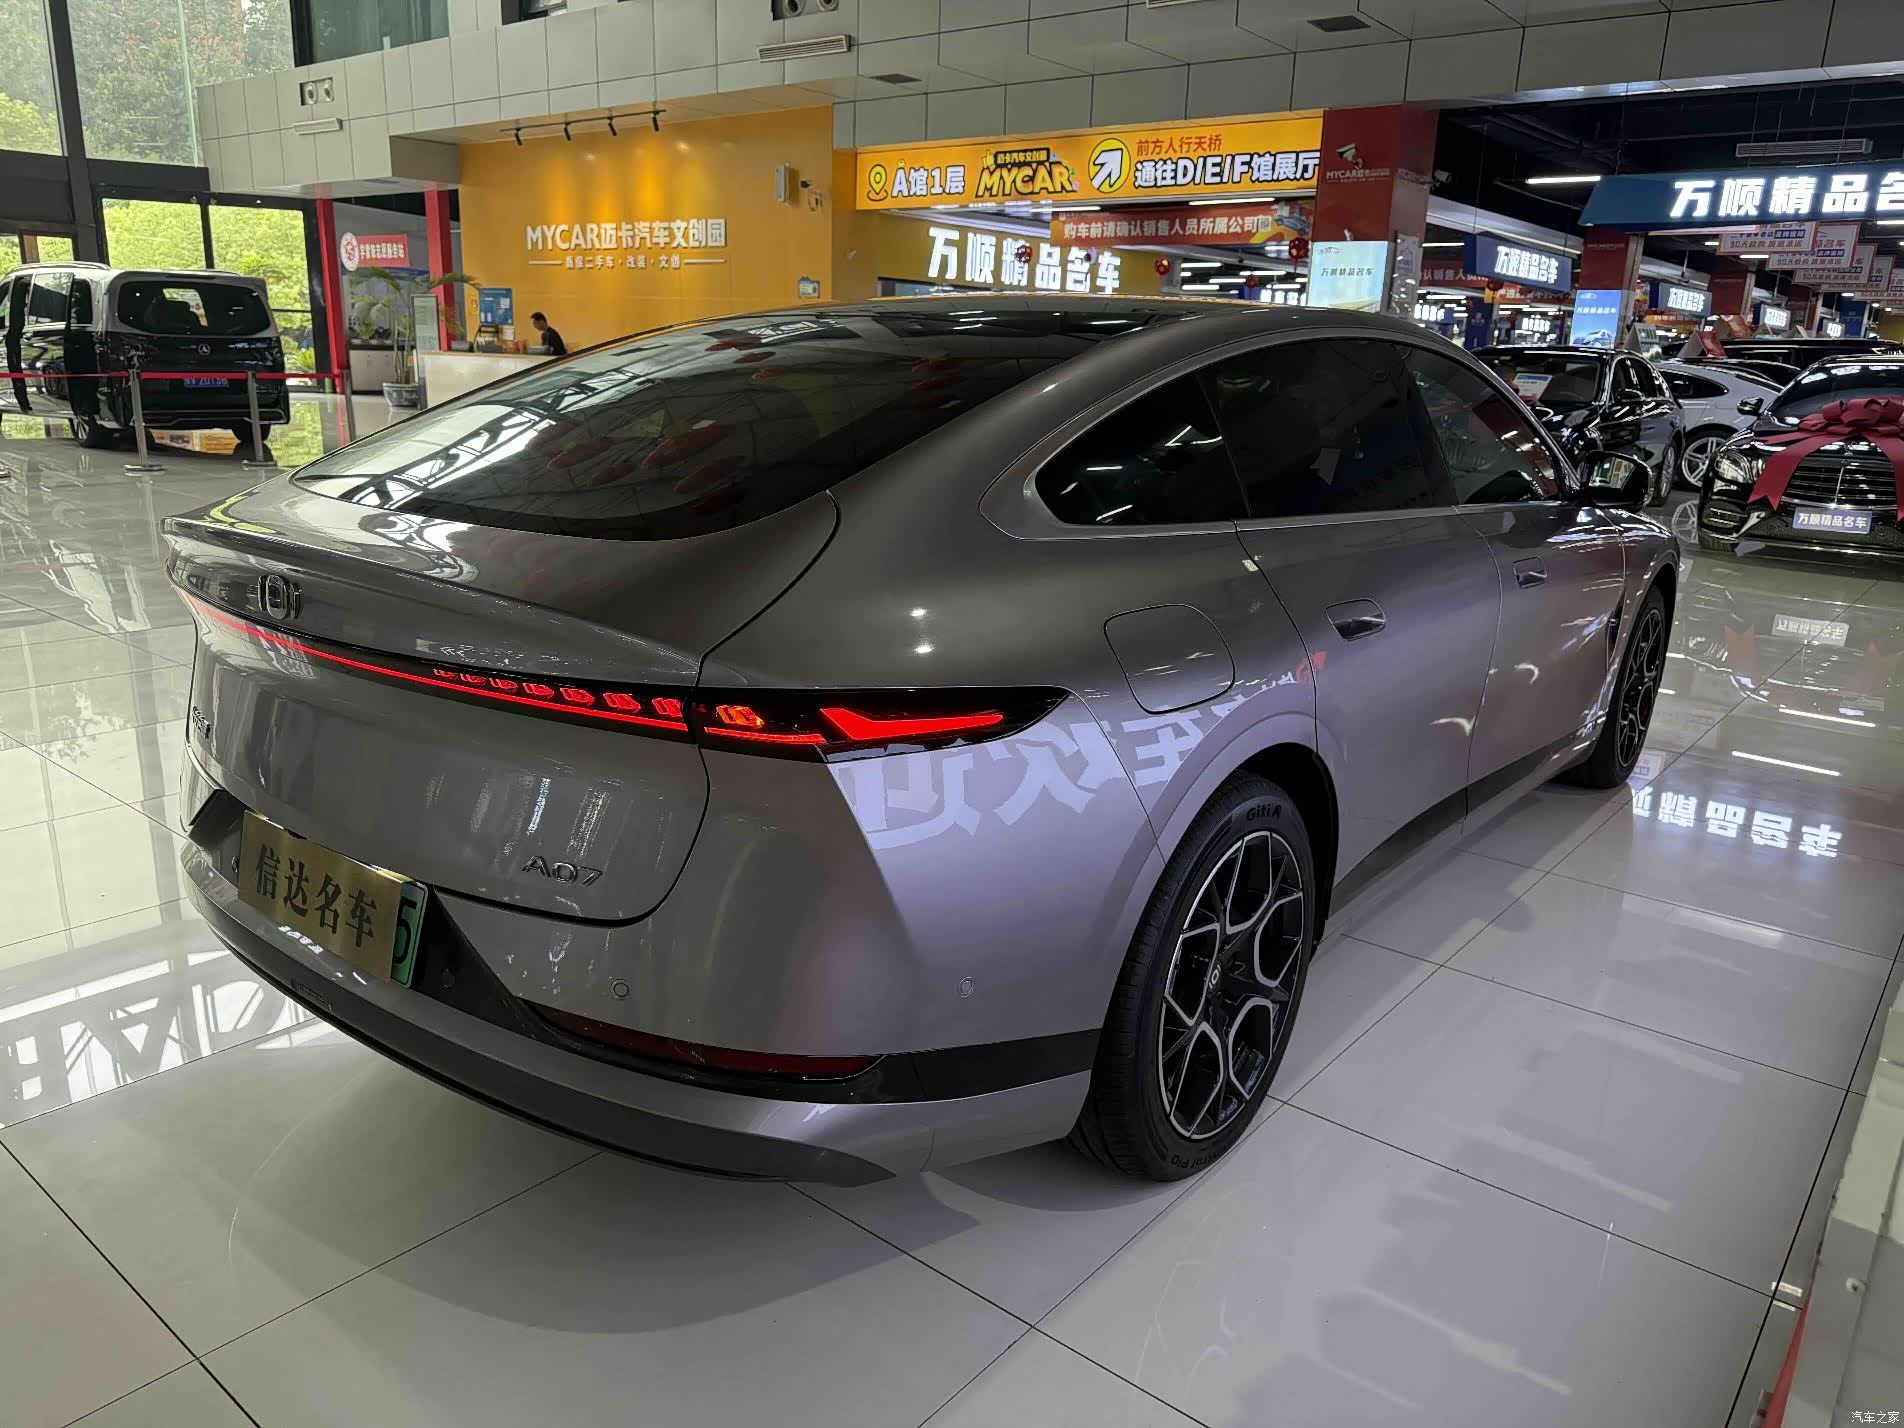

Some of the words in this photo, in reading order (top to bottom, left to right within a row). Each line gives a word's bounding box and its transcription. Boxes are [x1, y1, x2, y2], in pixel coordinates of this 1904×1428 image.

[1136, 133, 1223, 156] 前方人行天桥
[975, 163, 1077, 199] MYCAR
[927, 226, 1121, 293] 万顺精品名车
[1798, 512, 1867, 529] 万顺精品名车
[255, 842, 377, 947] 信达名车
